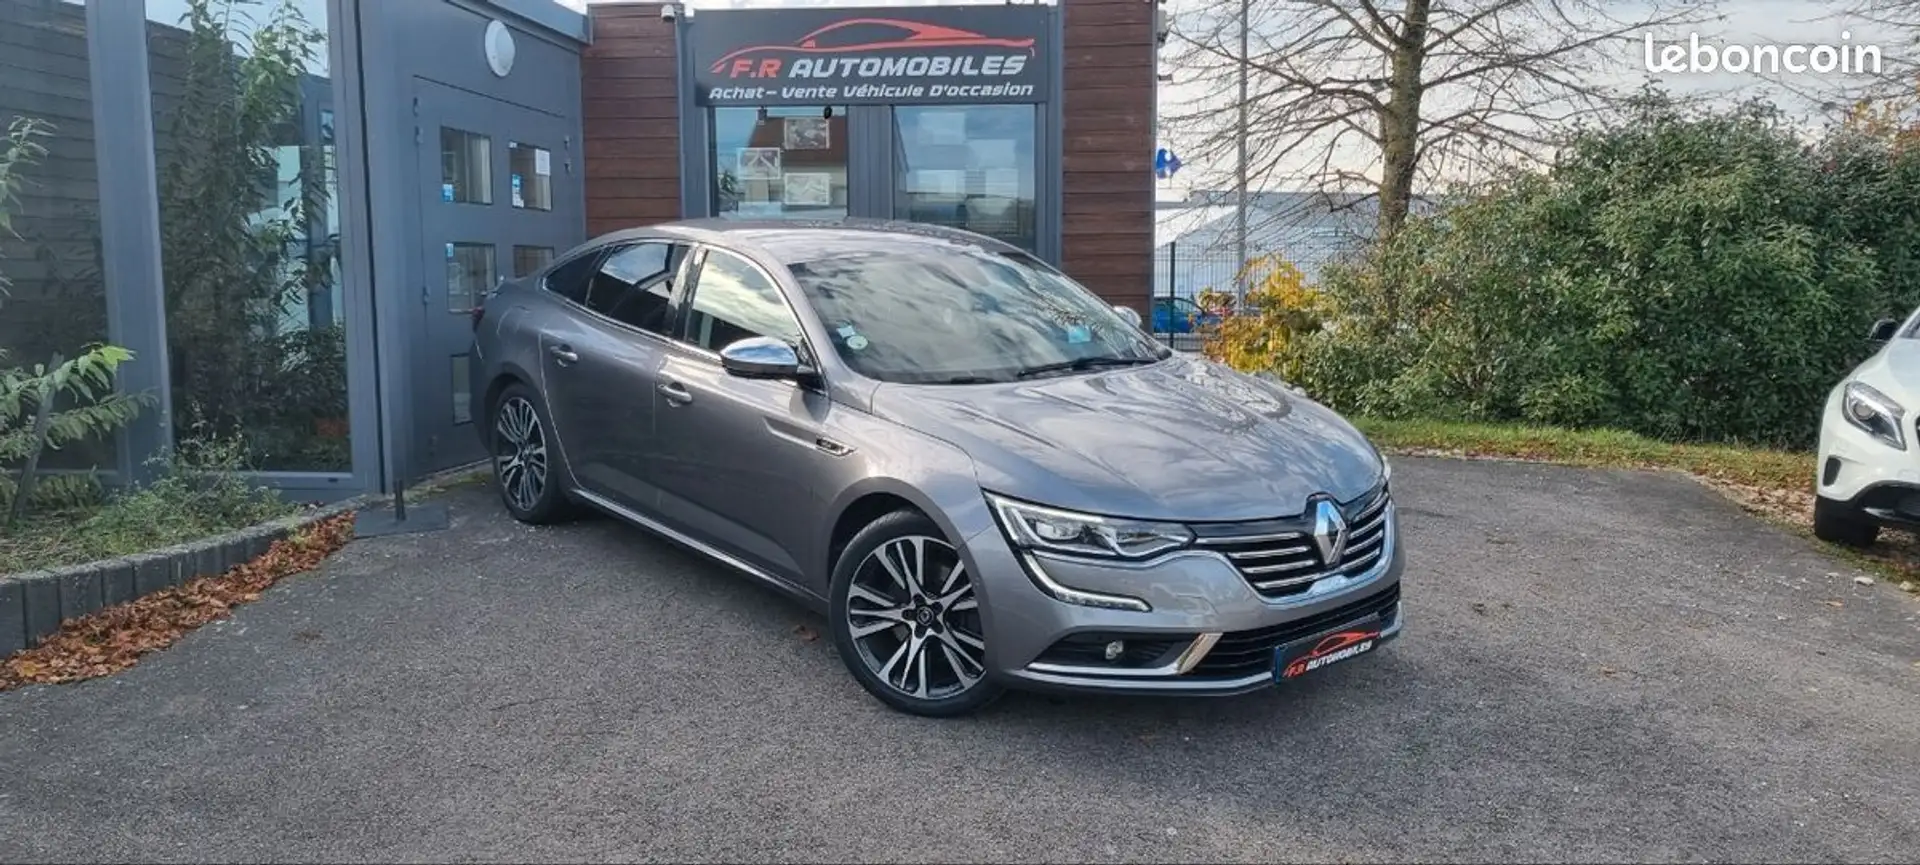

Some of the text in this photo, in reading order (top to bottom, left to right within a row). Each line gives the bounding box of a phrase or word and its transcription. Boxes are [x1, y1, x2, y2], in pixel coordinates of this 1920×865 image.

[730, 55, 1028, 78] F.R AUTOMOBILES
[781, 86, 838, 99] Vente
[844, 83, 925, 98] Véhicule
[928, 81, 1034, 97] D'occasion
[1305, 640, 1374, 671] AUTOMOBILES
